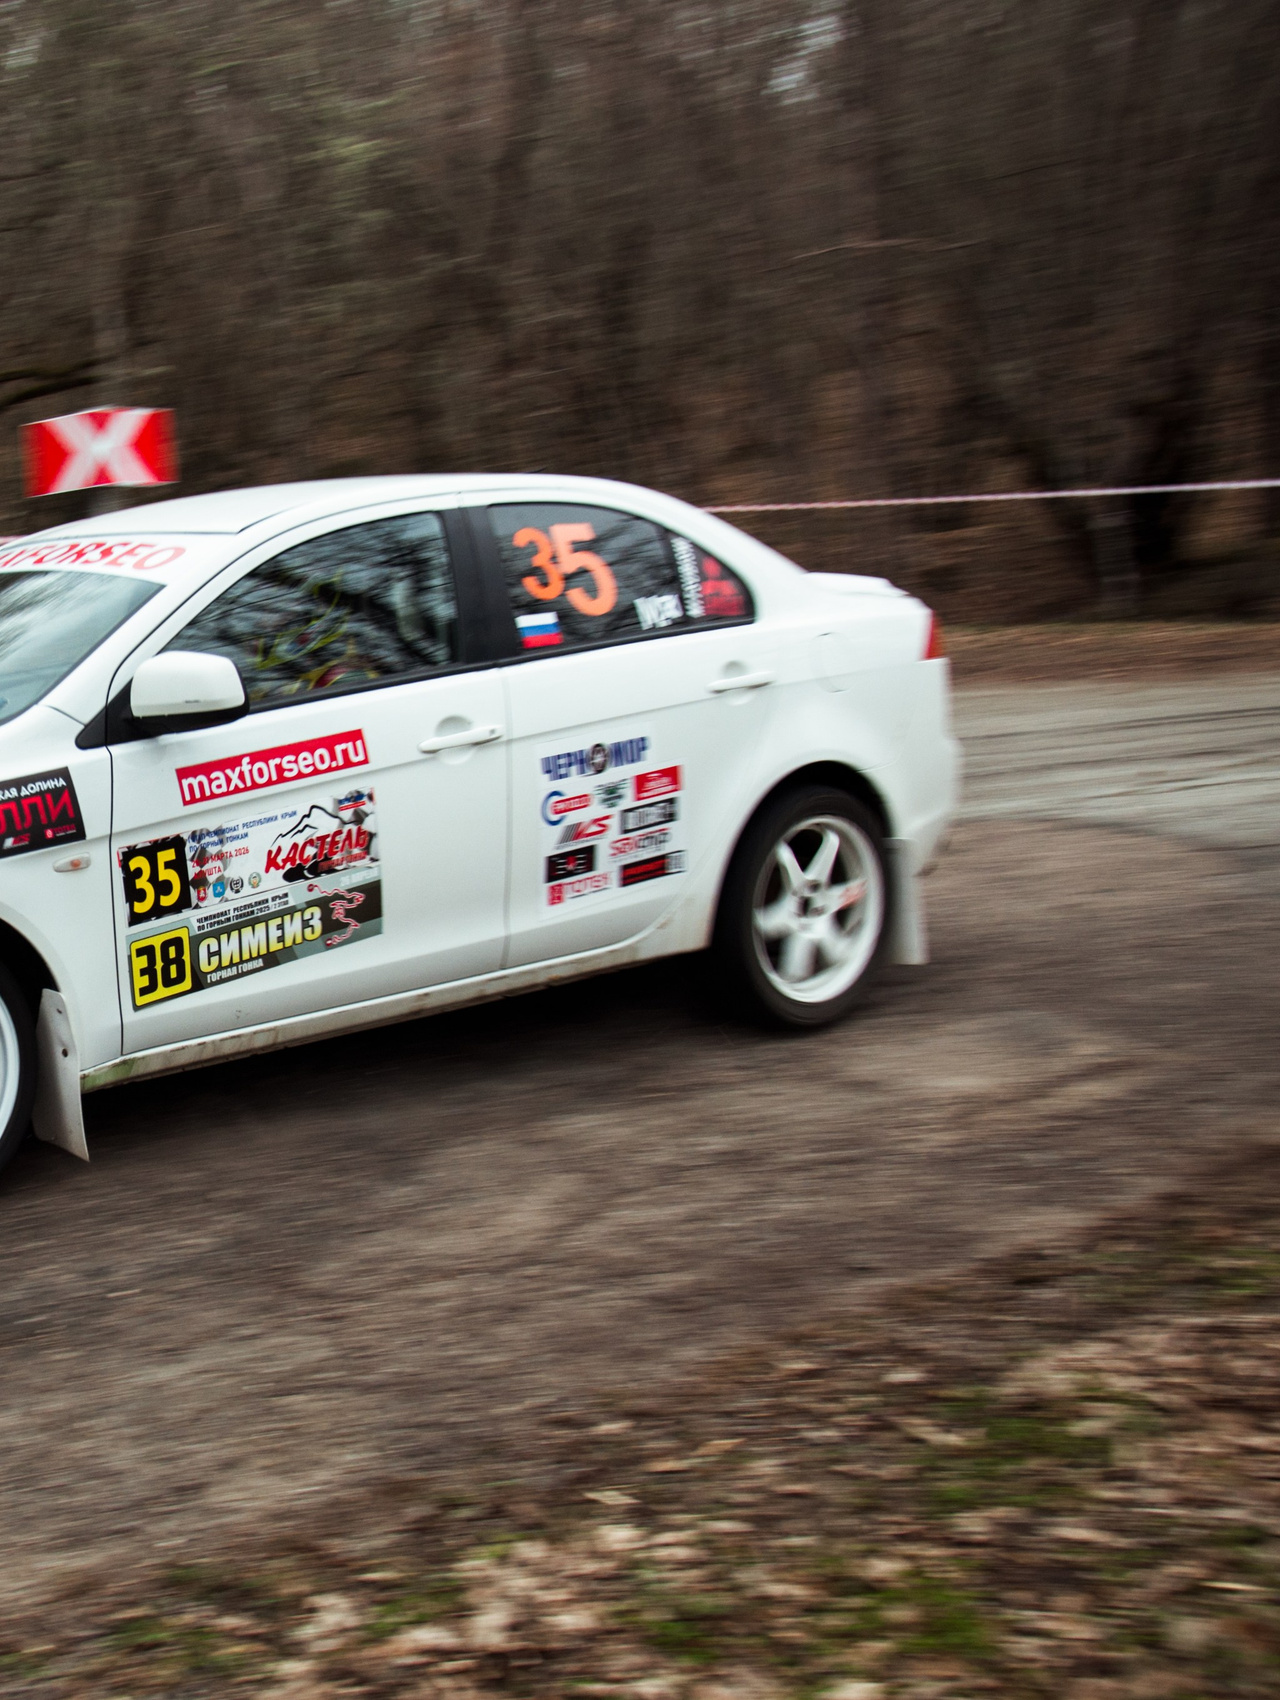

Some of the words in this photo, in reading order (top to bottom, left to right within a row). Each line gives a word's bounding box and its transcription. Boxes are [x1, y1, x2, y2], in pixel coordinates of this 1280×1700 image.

[512, 521, 619, 617] 35
[181, 737, 366, 803] maxforseo.ru
[19, 776, 67, 797] ДОЛИНА
[241, 814, 279, 830] РЕСПУБЛИКИ
[280, 810, 298, 821] КРЫМ
[226, 832, 249, 843] ГОНКАМ
[264, 825, 370, 874] КАСТЕЛЬ
[210, 851, 234, 864] МАРТА
[234, 846, 250, 857] 2026
[128, 847, 183, 915] 35
[196, 908, 231, 924] ЧЕМПИОНАТ
[232, 898, 269, 914] РЕСПУБЛИКИ
[271, 892, 289, 903] КРЫМ
[197, 923, 206, 932] ПО
[206, 916, 232, 931] ГОРНЫМ
[232, 909, 255, 924] ГОНКАМ
[198, 905, 324, 974] СИМЕИЗ
[135, 935, 187, 997] 38
[206, 964, 238, 984] ГОРНАЯ
[238, 958, 264, 974] ГОНКА
